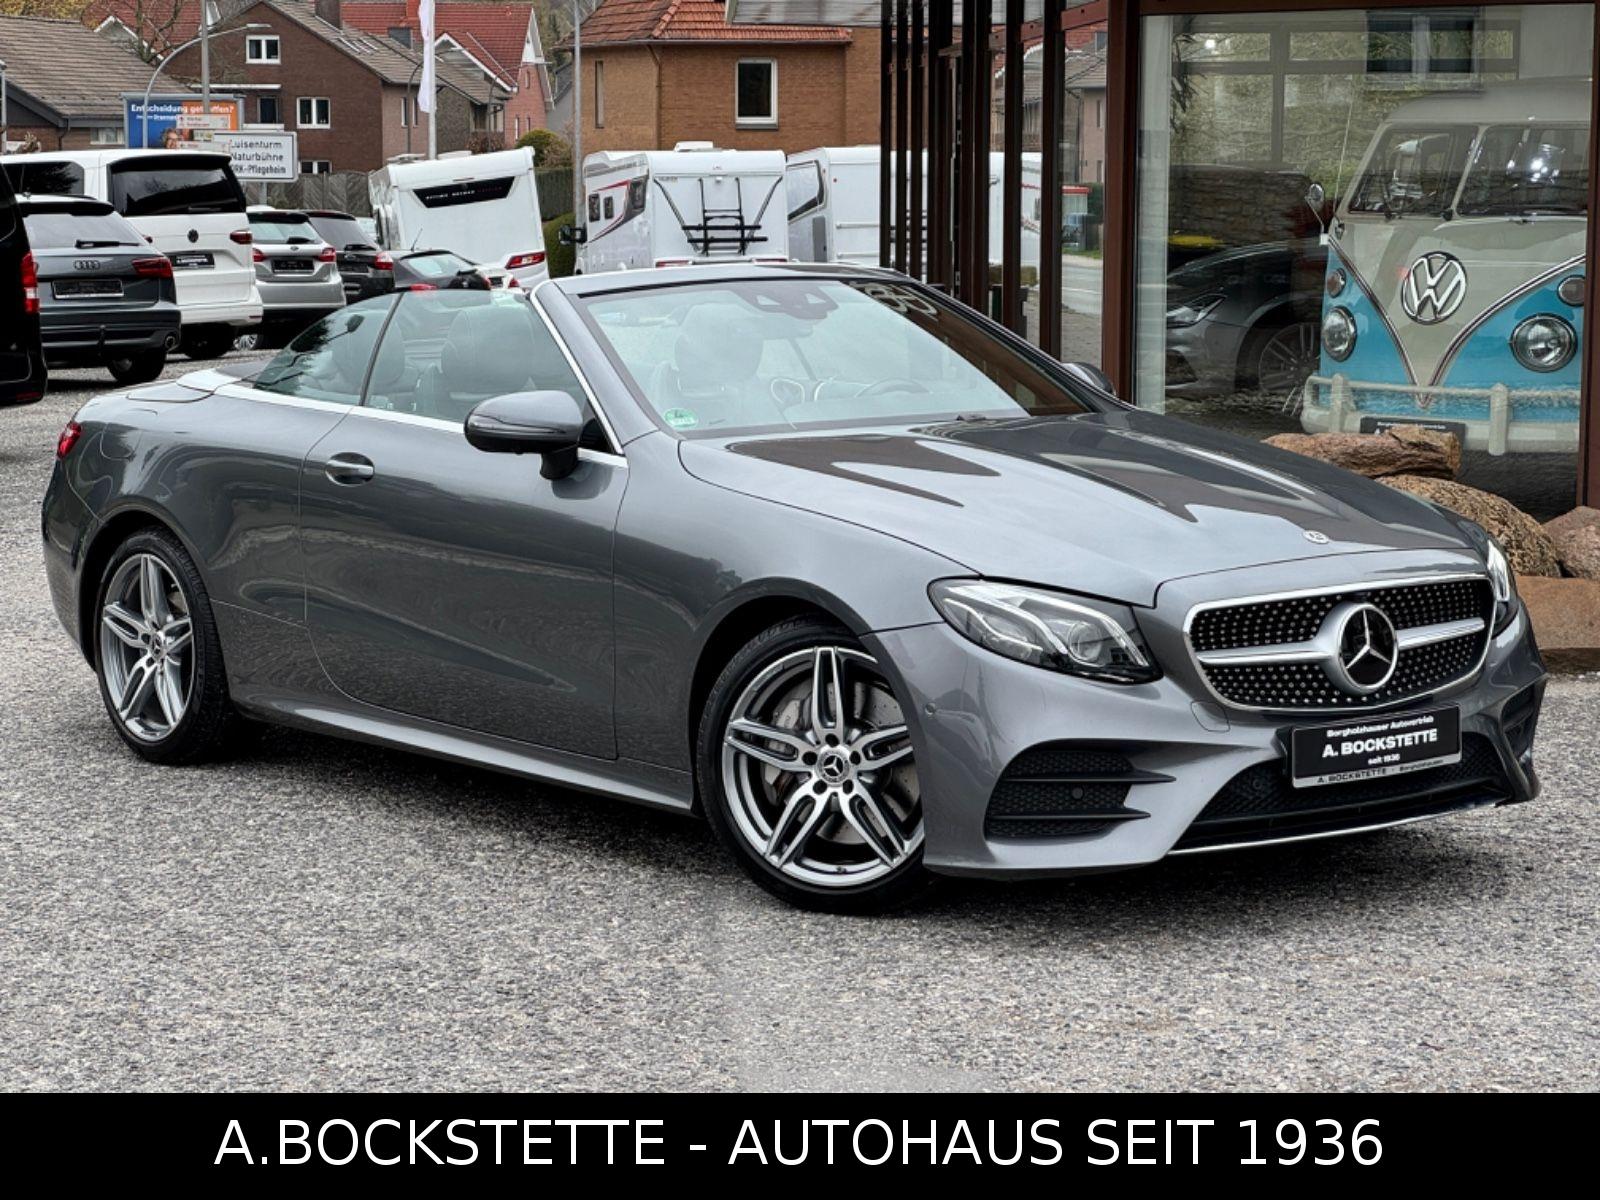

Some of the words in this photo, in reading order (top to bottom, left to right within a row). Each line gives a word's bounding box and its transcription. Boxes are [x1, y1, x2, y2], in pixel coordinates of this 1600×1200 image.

[190, 105, 234, 115] getoffen?
[1390, 715, 1435, 730] Autovertrieb
[1322, 744, 1339, 758] A.
[1341, 728, 1438, 755] BOCKSTETTE
